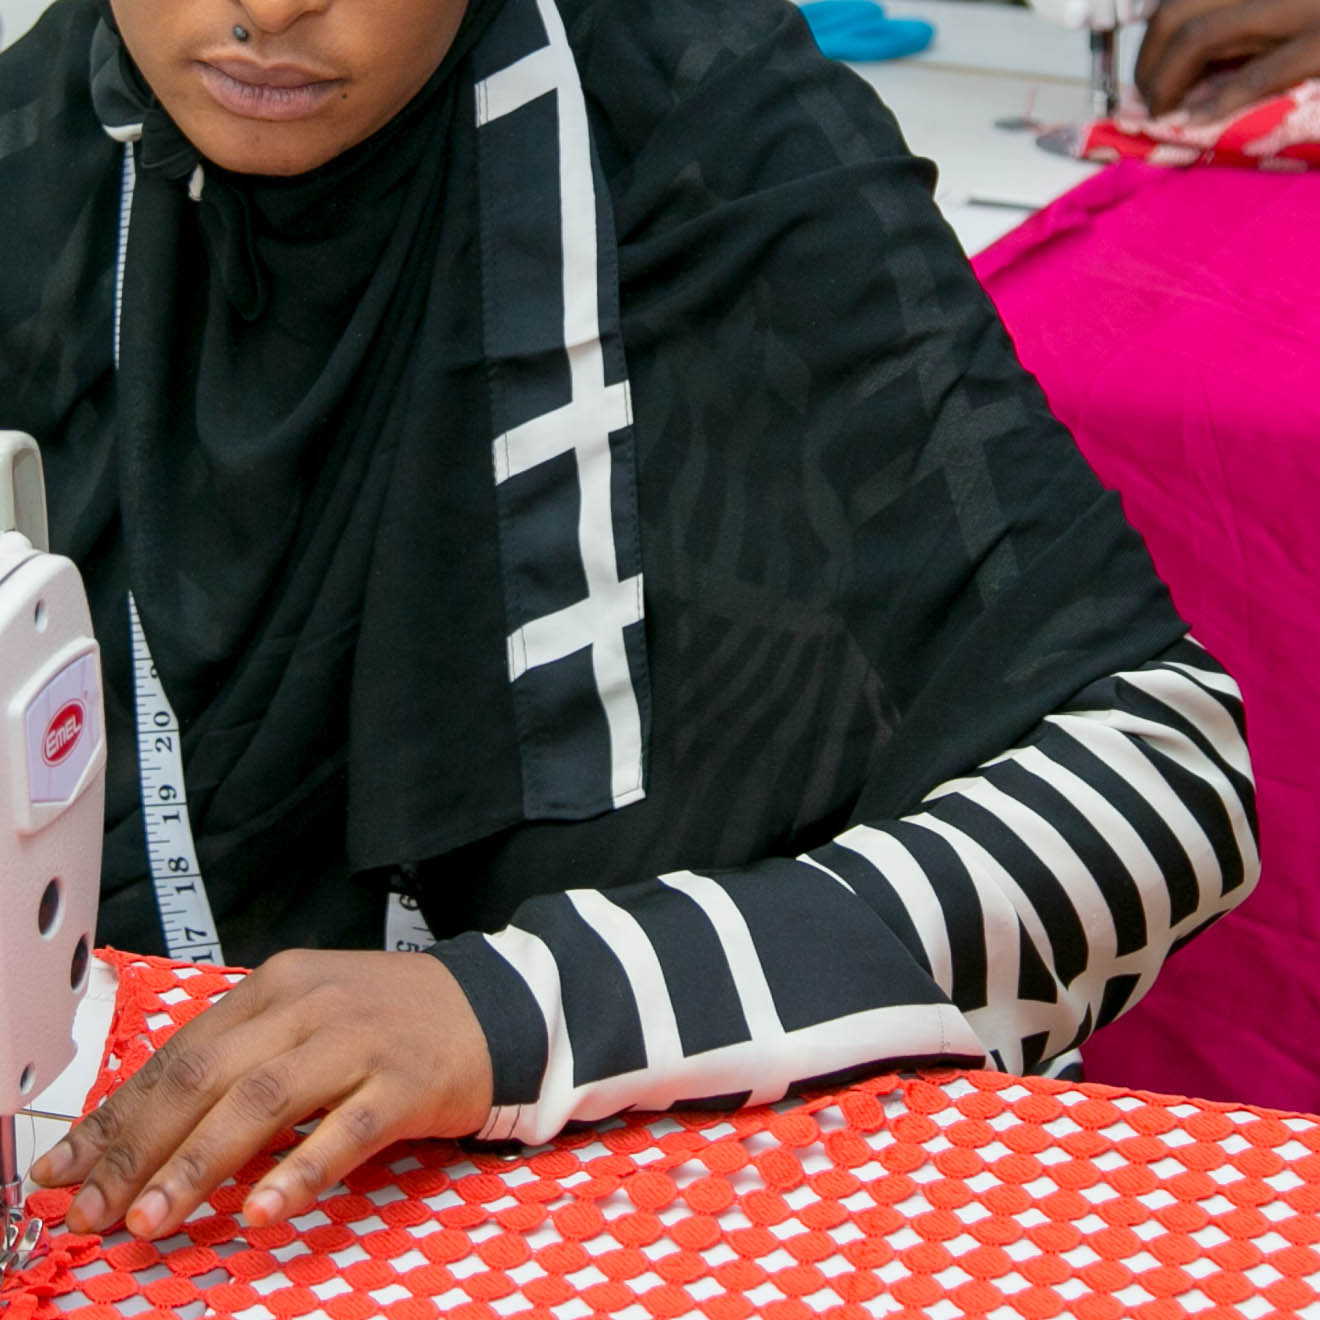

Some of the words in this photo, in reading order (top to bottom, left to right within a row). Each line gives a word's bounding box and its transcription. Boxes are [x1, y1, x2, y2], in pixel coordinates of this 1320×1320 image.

[46, 714, 82, 759] EMEL
[153, 711, 173, 753] 20
[158, 784, 182, 824] 19
[168, 856, 198, 894] 18
[183, 927, 215, 964] 17
